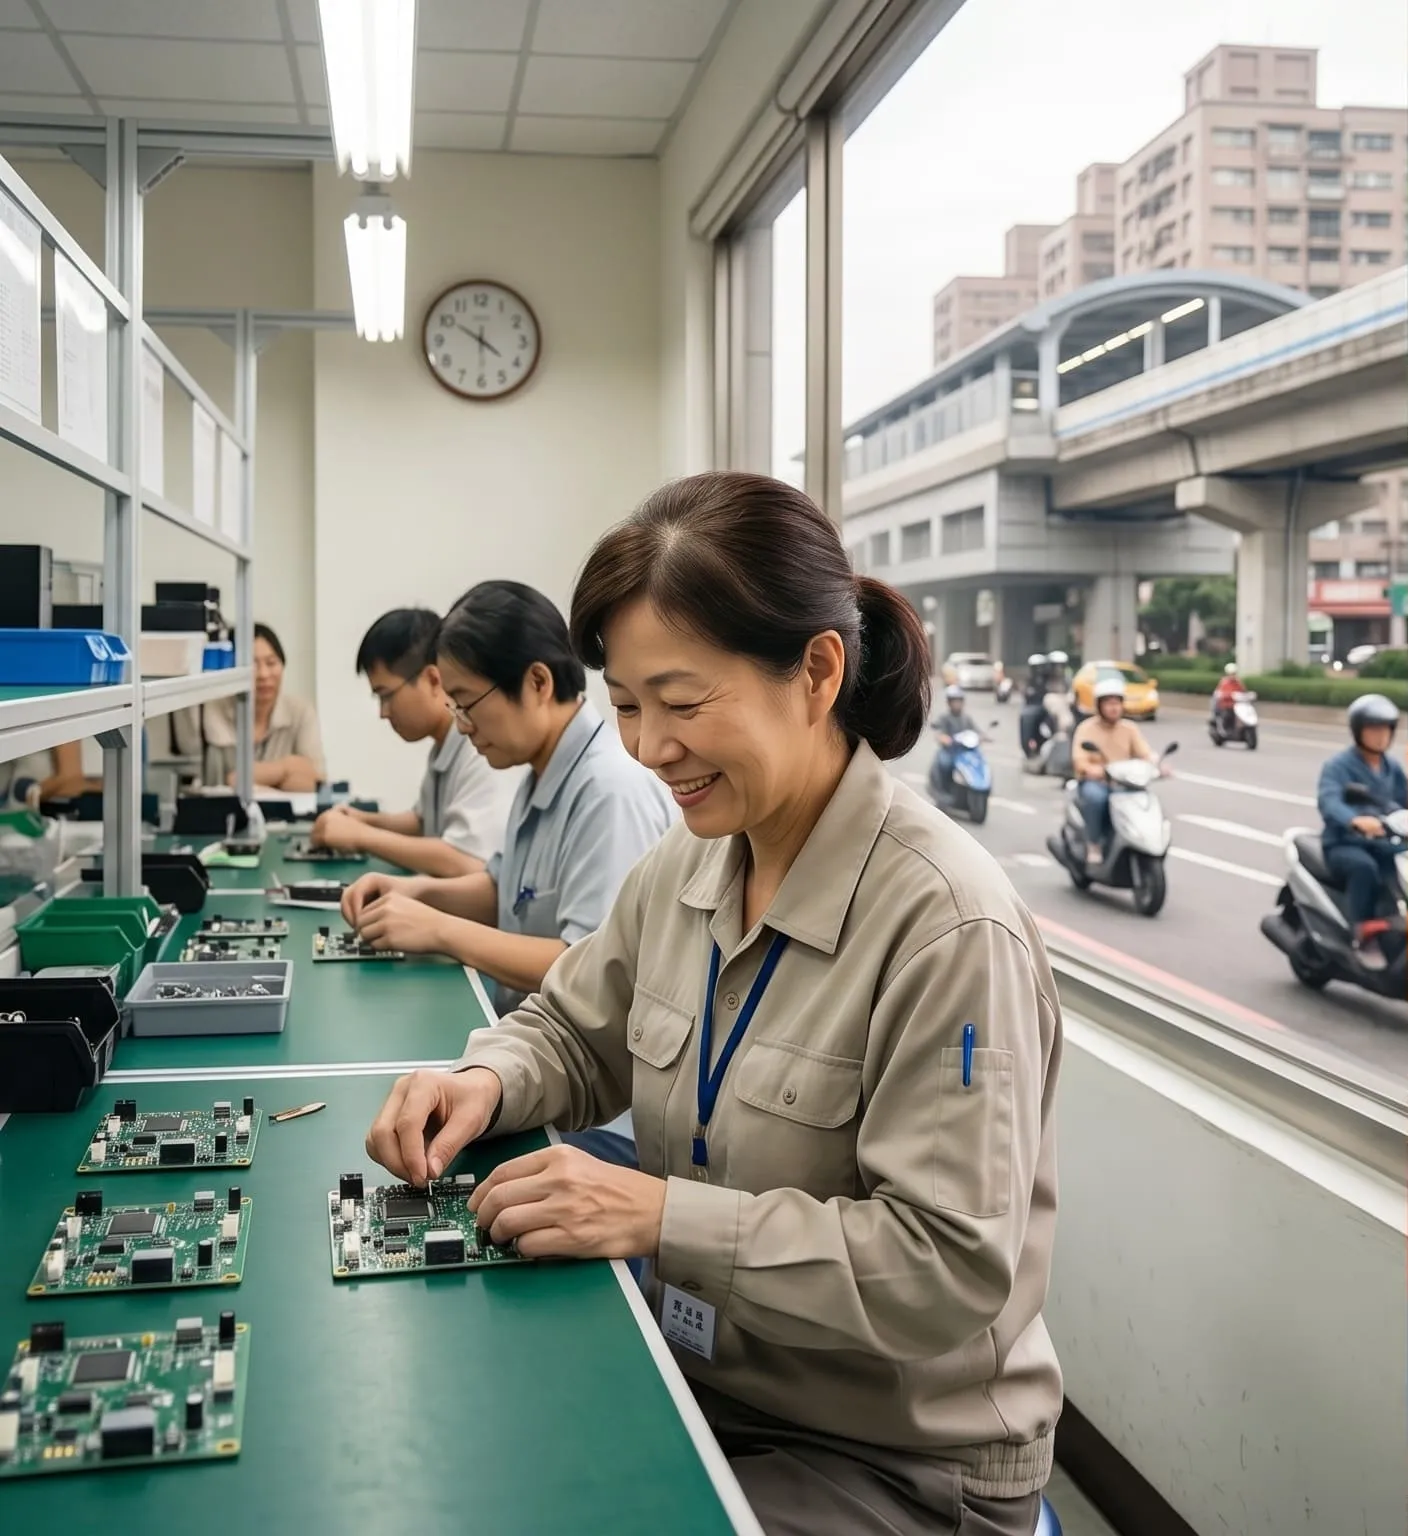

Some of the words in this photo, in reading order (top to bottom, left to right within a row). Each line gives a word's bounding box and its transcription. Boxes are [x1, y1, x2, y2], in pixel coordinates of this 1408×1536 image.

[455, 299, 466, 313] 11
[474, 293, 488, 308] 12
[440, 315, 455, 327] 10
[511, 315, 521, 329] 2
[519, 335, 529, 349] 3
[512, 356, 521, 371] 4
[458, 369, 466, 384] 7
[477, 374, 486, 388] 6
[497, 370, 507, 384] 5
